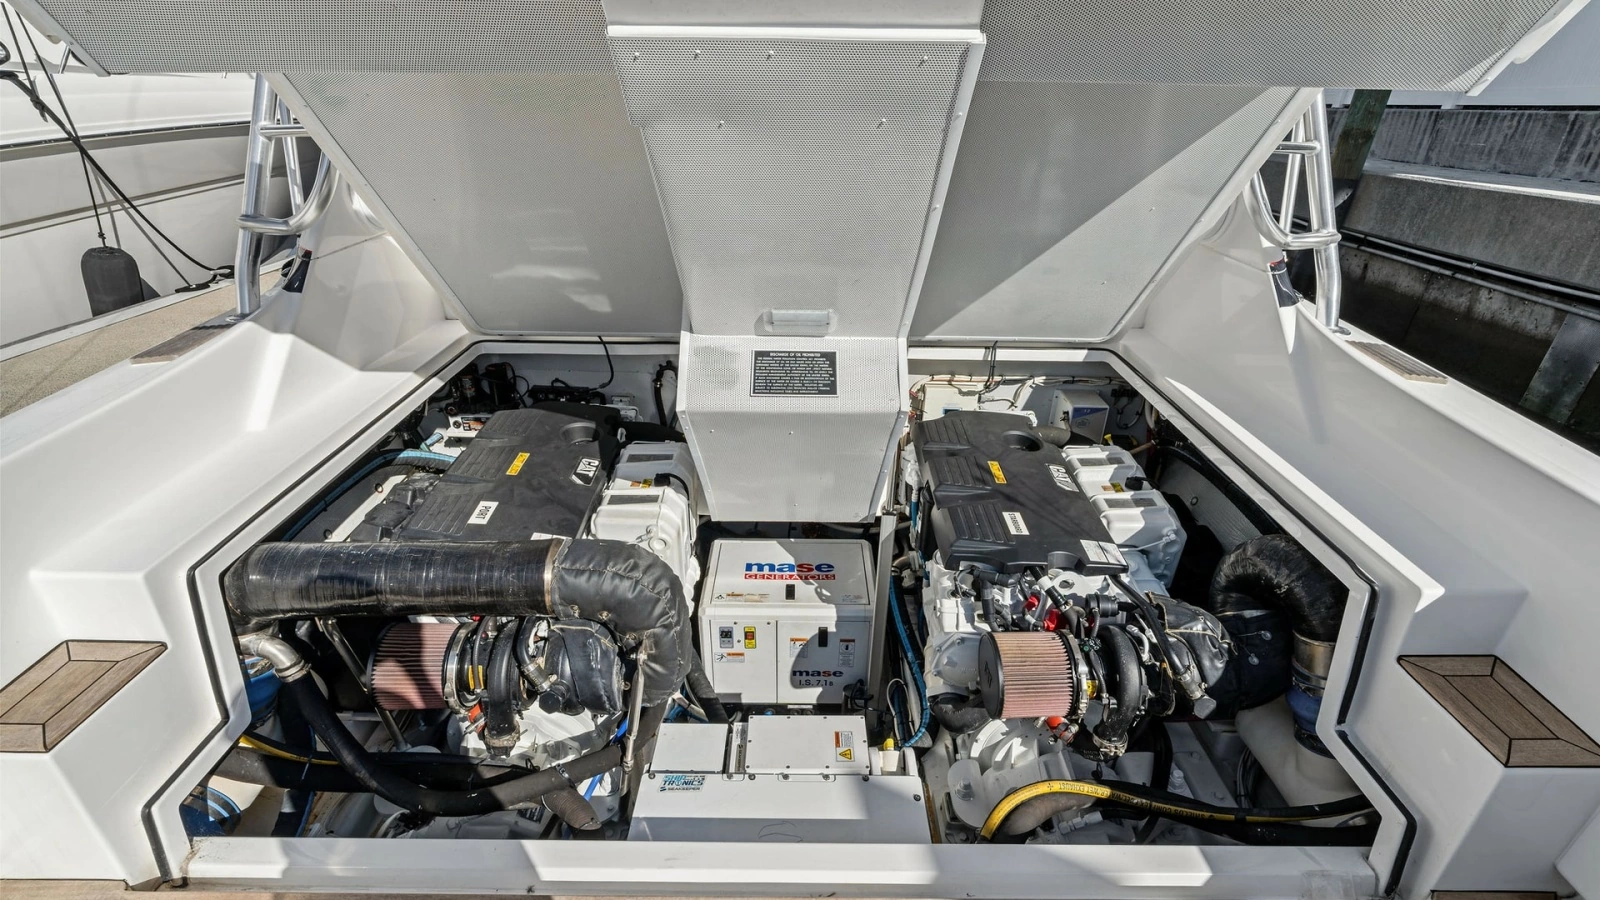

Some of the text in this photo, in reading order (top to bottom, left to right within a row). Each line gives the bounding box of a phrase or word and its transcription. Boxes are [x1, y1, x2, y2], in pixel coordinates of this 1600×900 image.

[576, 458, 600, 477] CAT
[475, 505, 491, 519] PORT
[745, 562, 835, 573] mase
[792, 670, 844, 678] mase
